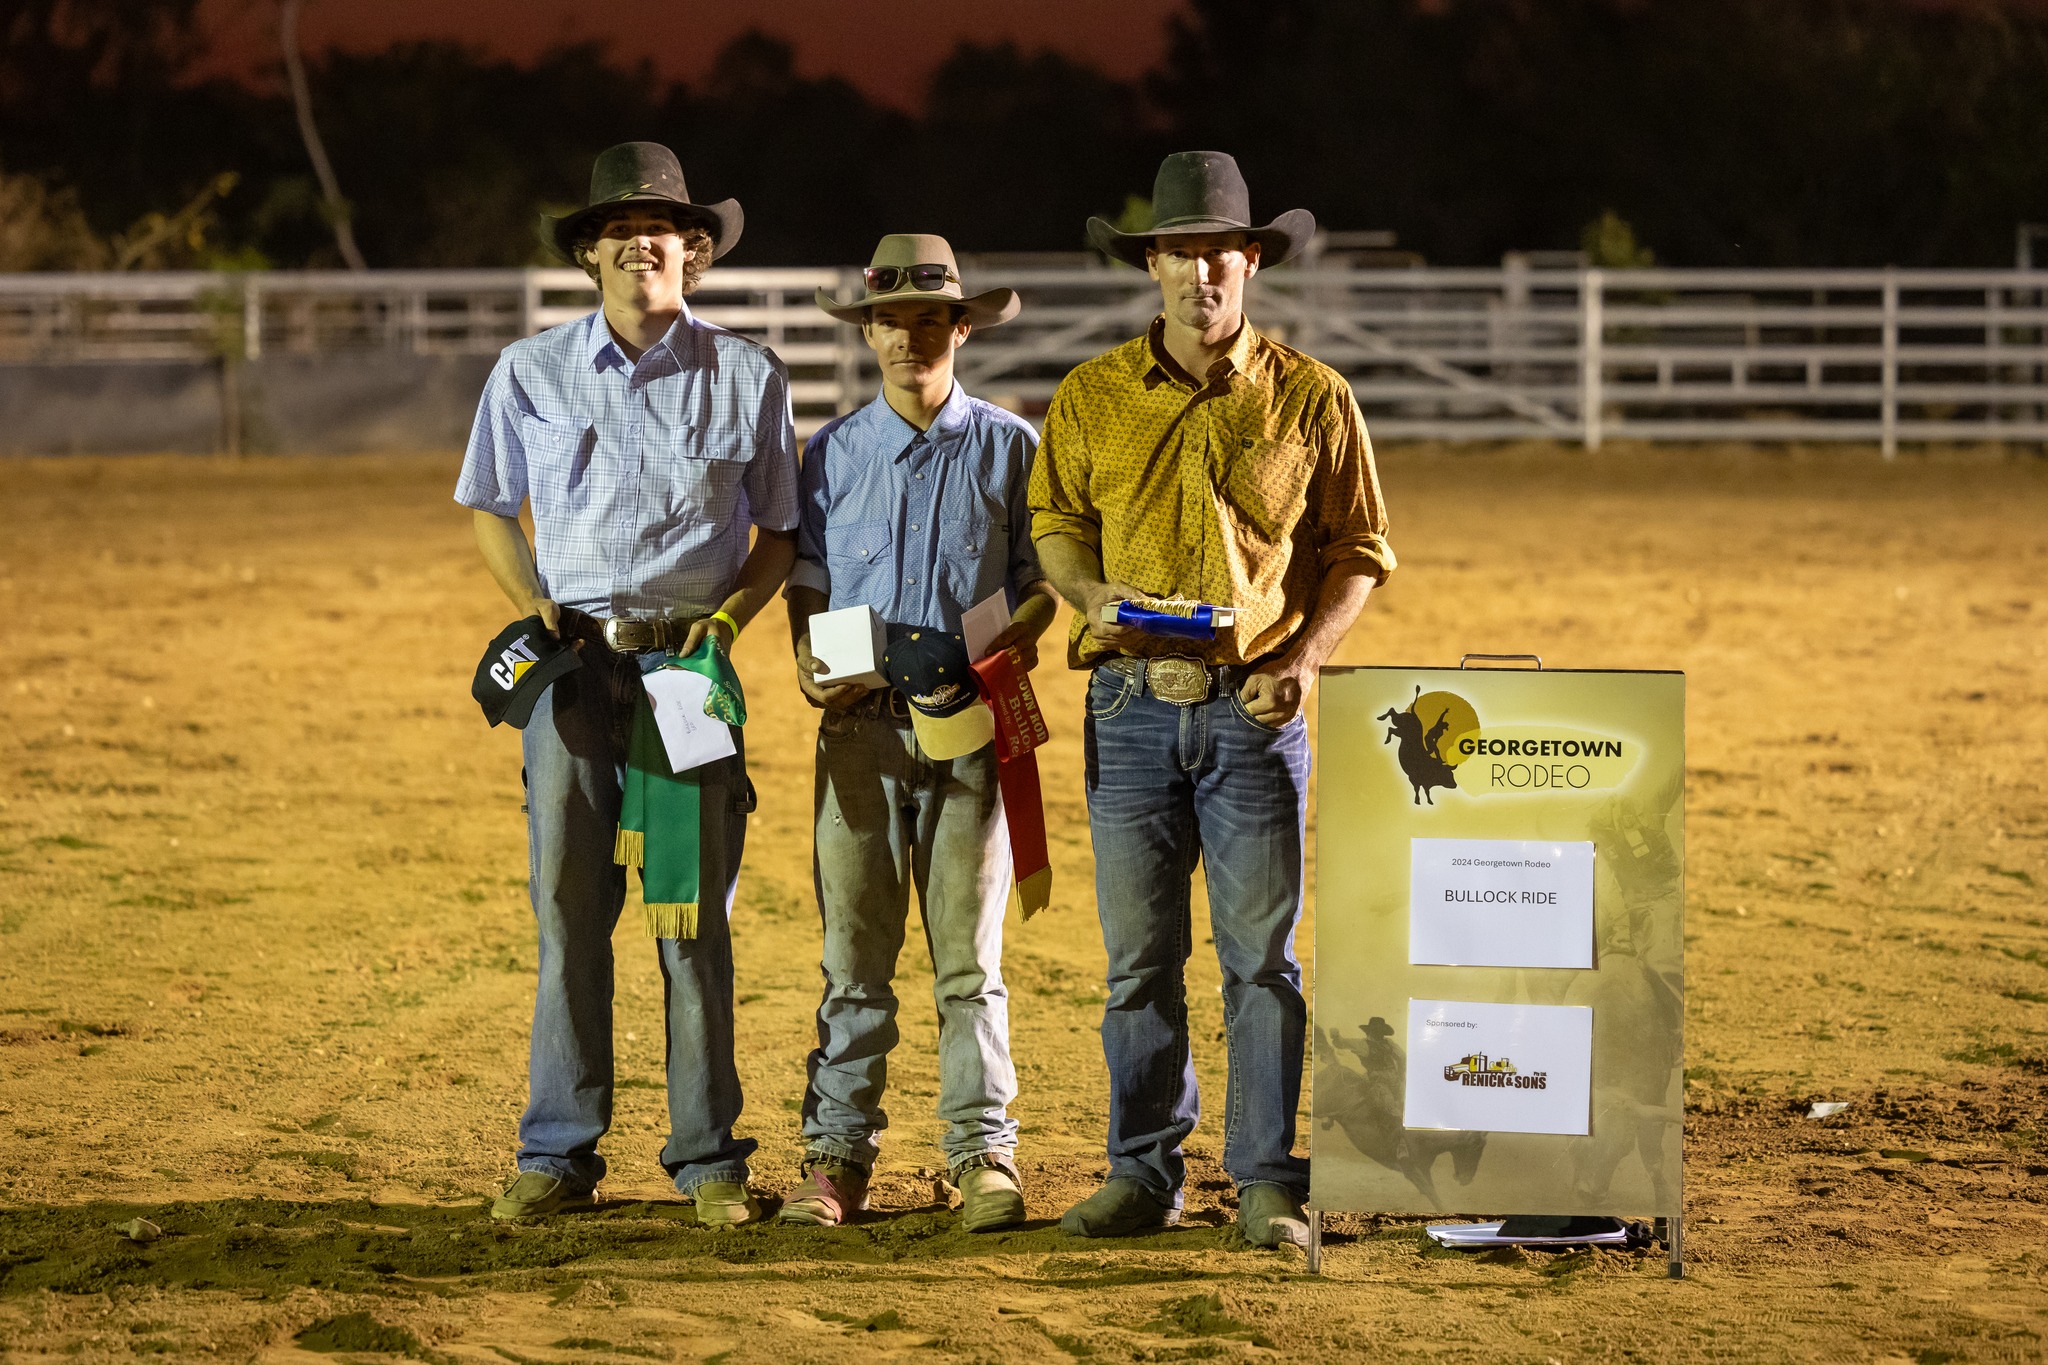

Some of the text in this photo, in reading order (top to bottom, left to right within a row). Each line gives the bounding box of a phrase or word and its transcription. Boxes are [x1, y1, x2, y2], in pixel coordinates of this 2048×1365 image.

[1458, 739, 1622, 757] GEORGETOWN
[1491, 763, 1590, 788] RODEO
[1452, 858, 1551, 868] 2024 Georgetown Rodeo
[1445, 889, 1557, 905] BULLOCK RIDE
[1426, 1019, 1478, 1029] Sponsored by:
[1462, 1073, 1546, 1089] RENICK & SONS
